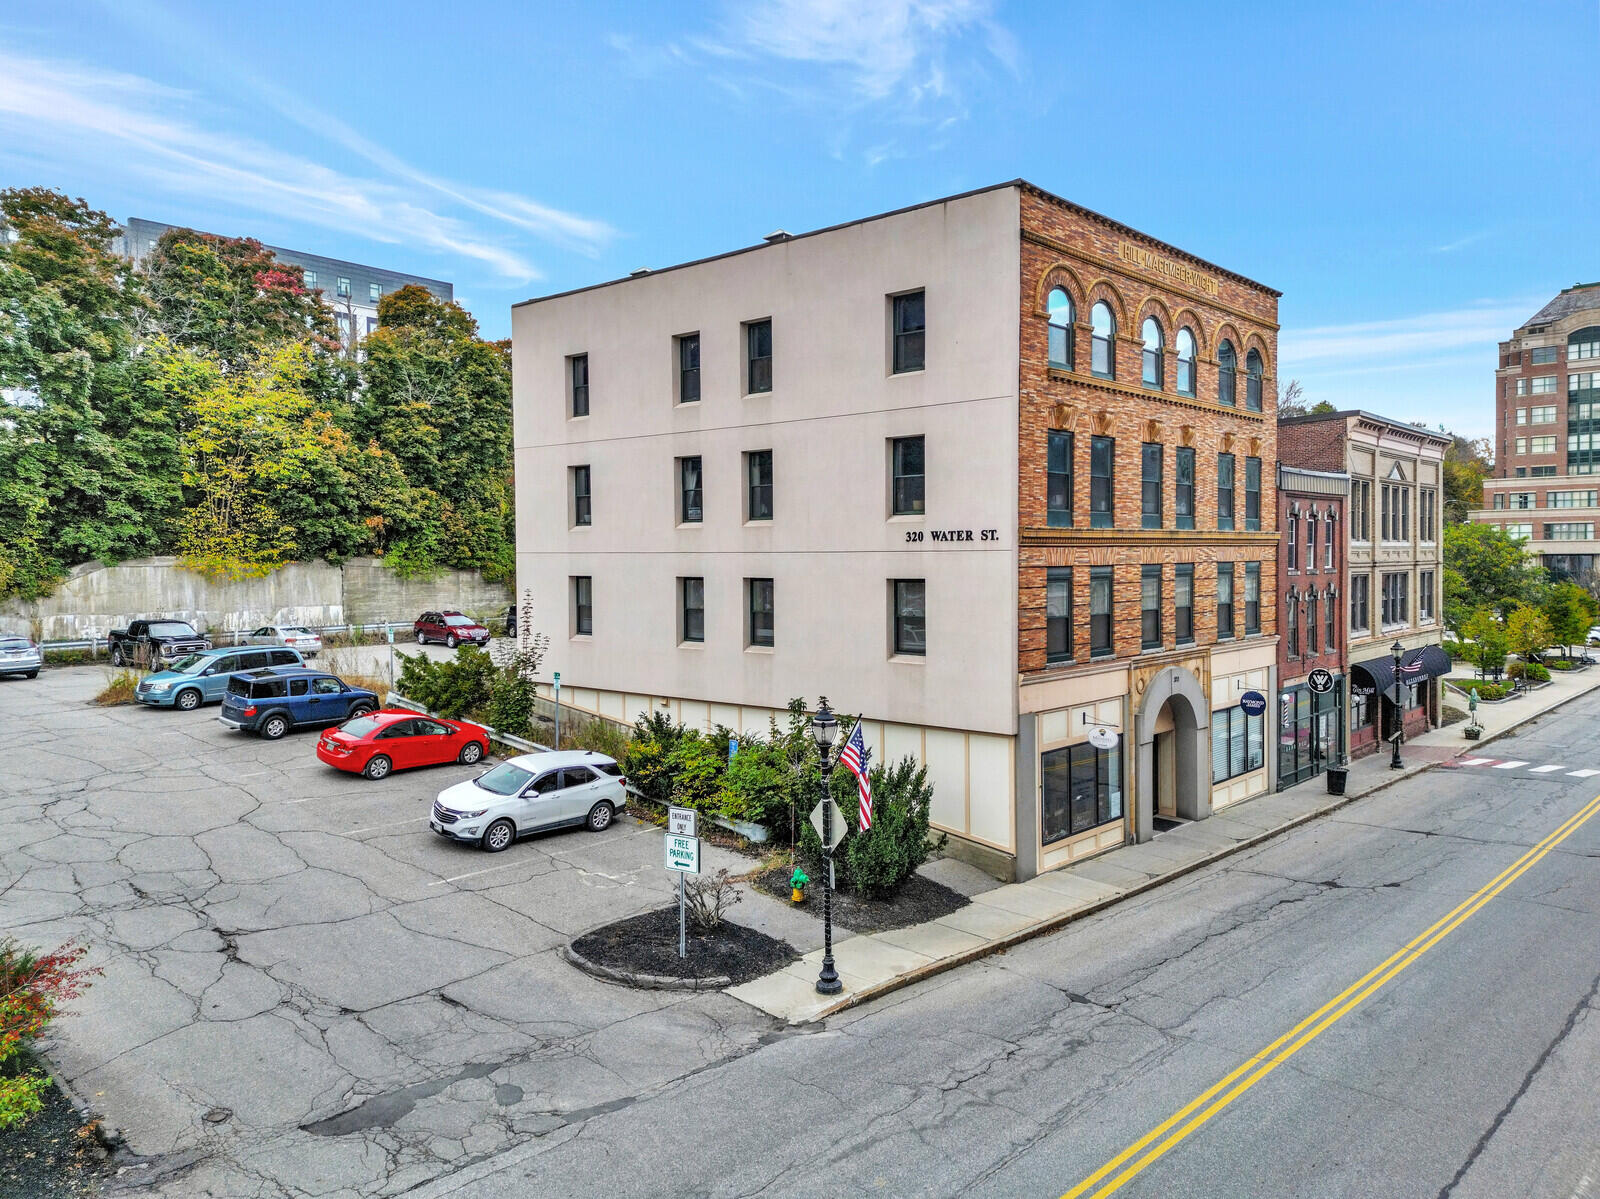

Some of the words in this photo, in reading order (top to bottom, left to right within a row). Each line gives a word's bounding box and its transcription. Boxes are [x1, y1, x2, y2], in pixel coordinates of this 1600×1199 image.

[1123, 243, 1141, 265] HILL
[905, 531, 924, 542] 320
[930, 530, 974, 542] WATER
[980, 529, 999, 541] ST.
[672, 812, 692, 821] ENTRANCE
[676, 822, 687, 831] ONLY
[674, 839, 689, 849] FREE
[669, 848, 694, 861] PARKING
